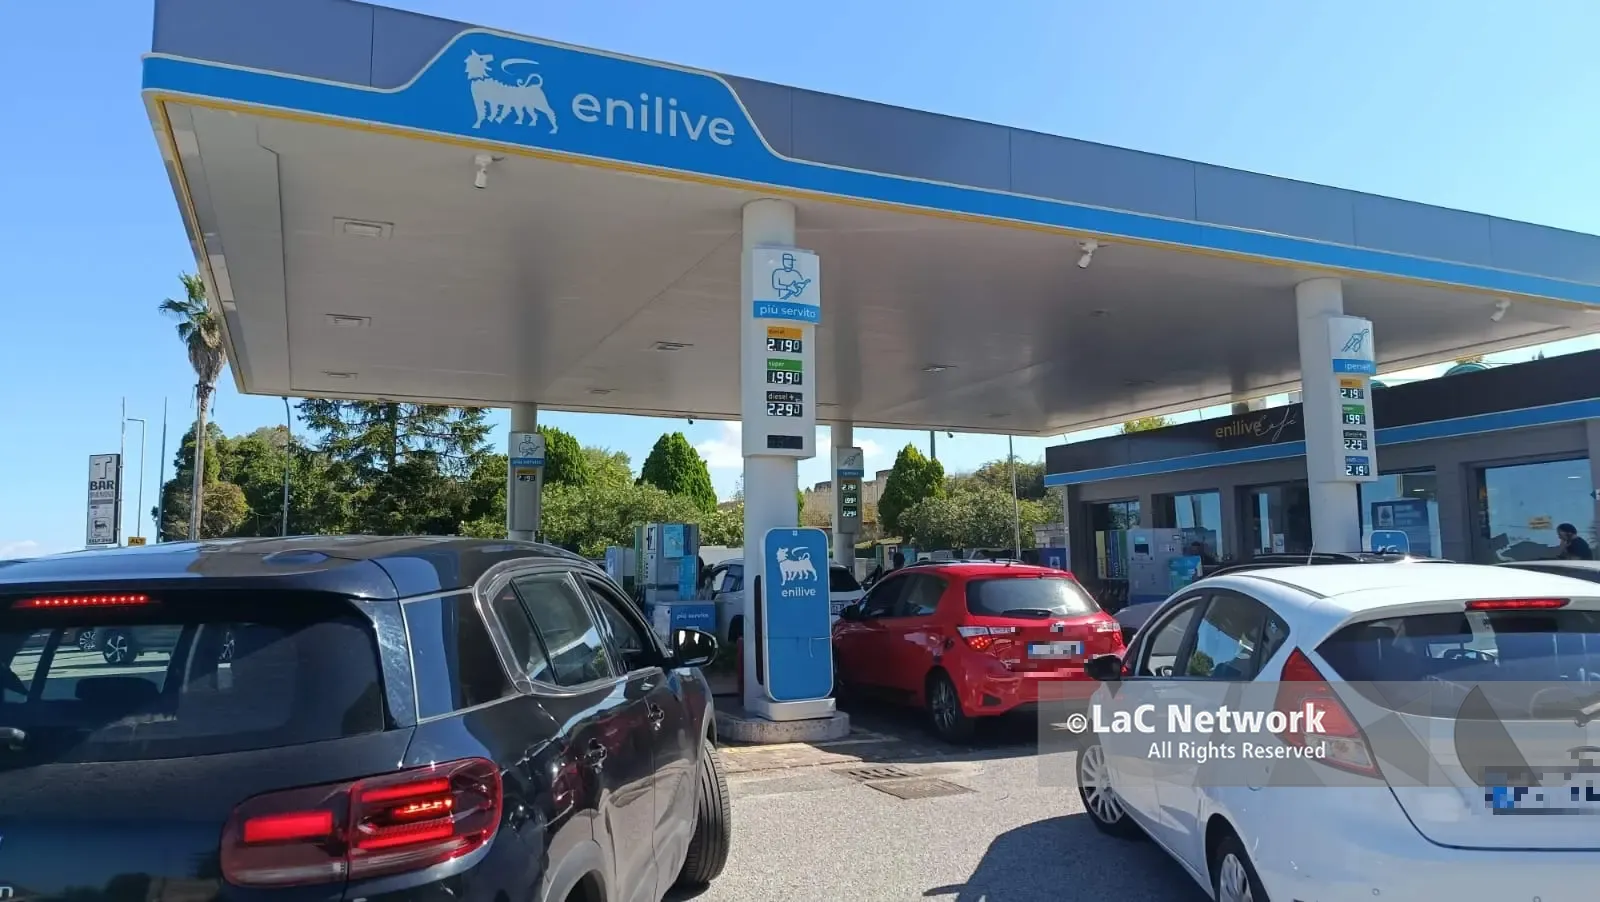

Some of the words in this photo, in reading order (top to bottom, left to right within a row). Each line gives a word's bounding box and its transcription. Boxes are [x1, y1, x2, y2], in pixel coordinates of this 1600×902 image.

[572, 92, 735, 146] enilive
[760, 304, 778, 316] più
[781, 307, 816, 318] servito
[1216, 420, 1262, 438] enilive
[90, 480, 114, 490] BAR
[781, 586, 817, 598] enilive
